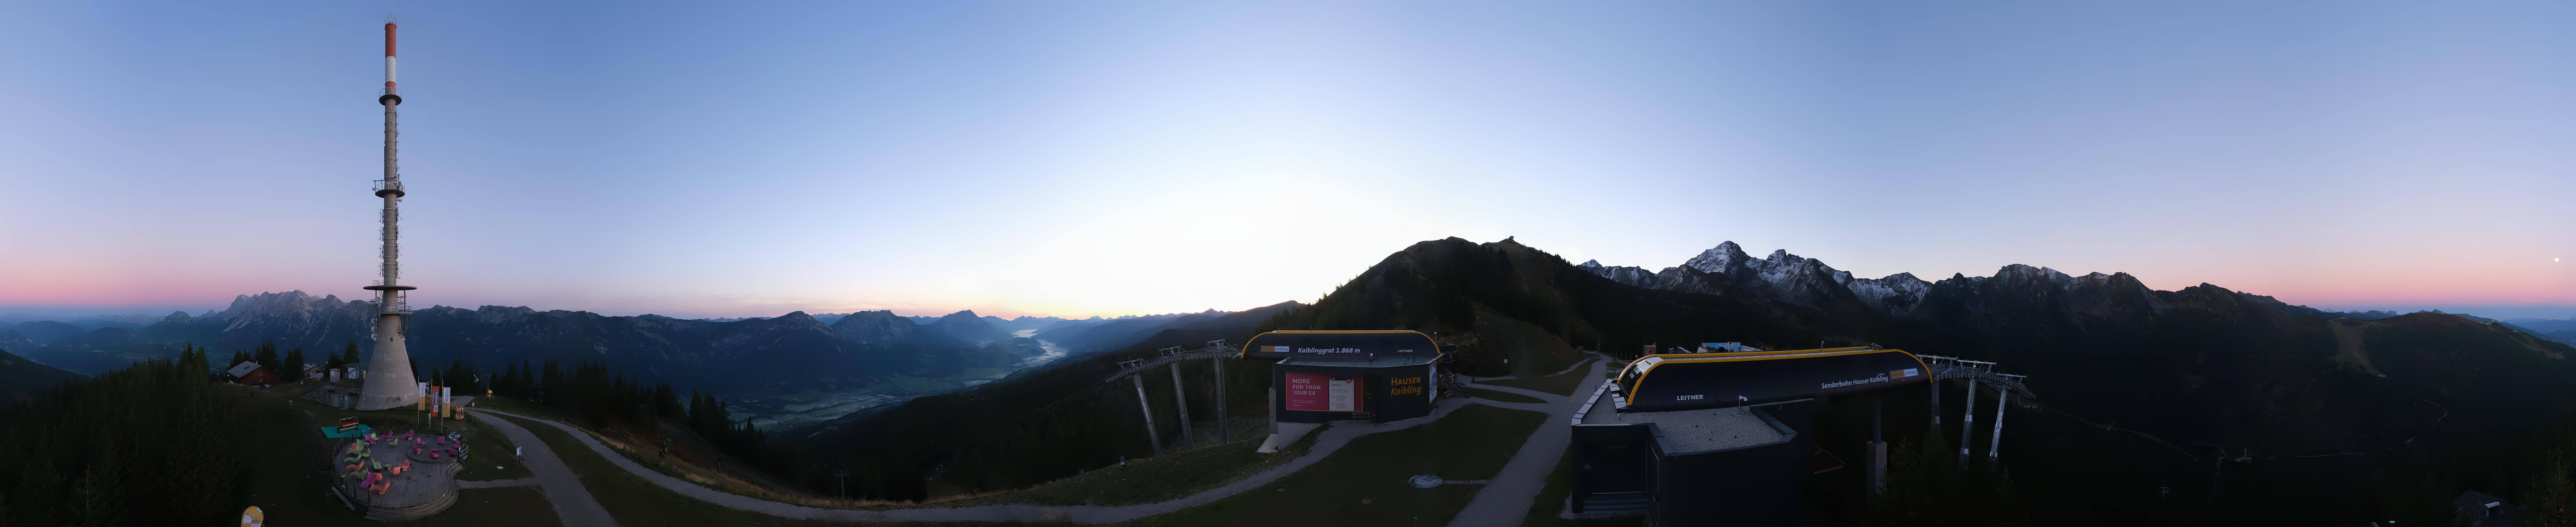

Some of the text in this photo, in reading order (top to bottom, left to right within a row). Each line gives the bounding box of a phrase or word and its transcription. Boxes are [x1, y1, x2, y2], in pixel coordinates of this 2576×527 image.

[1391, 377, 1421, 386] HAUSER
[1821, 380, 1852, 389] Senderbahn
[1391, 386, 1421, 396] Kaibling
